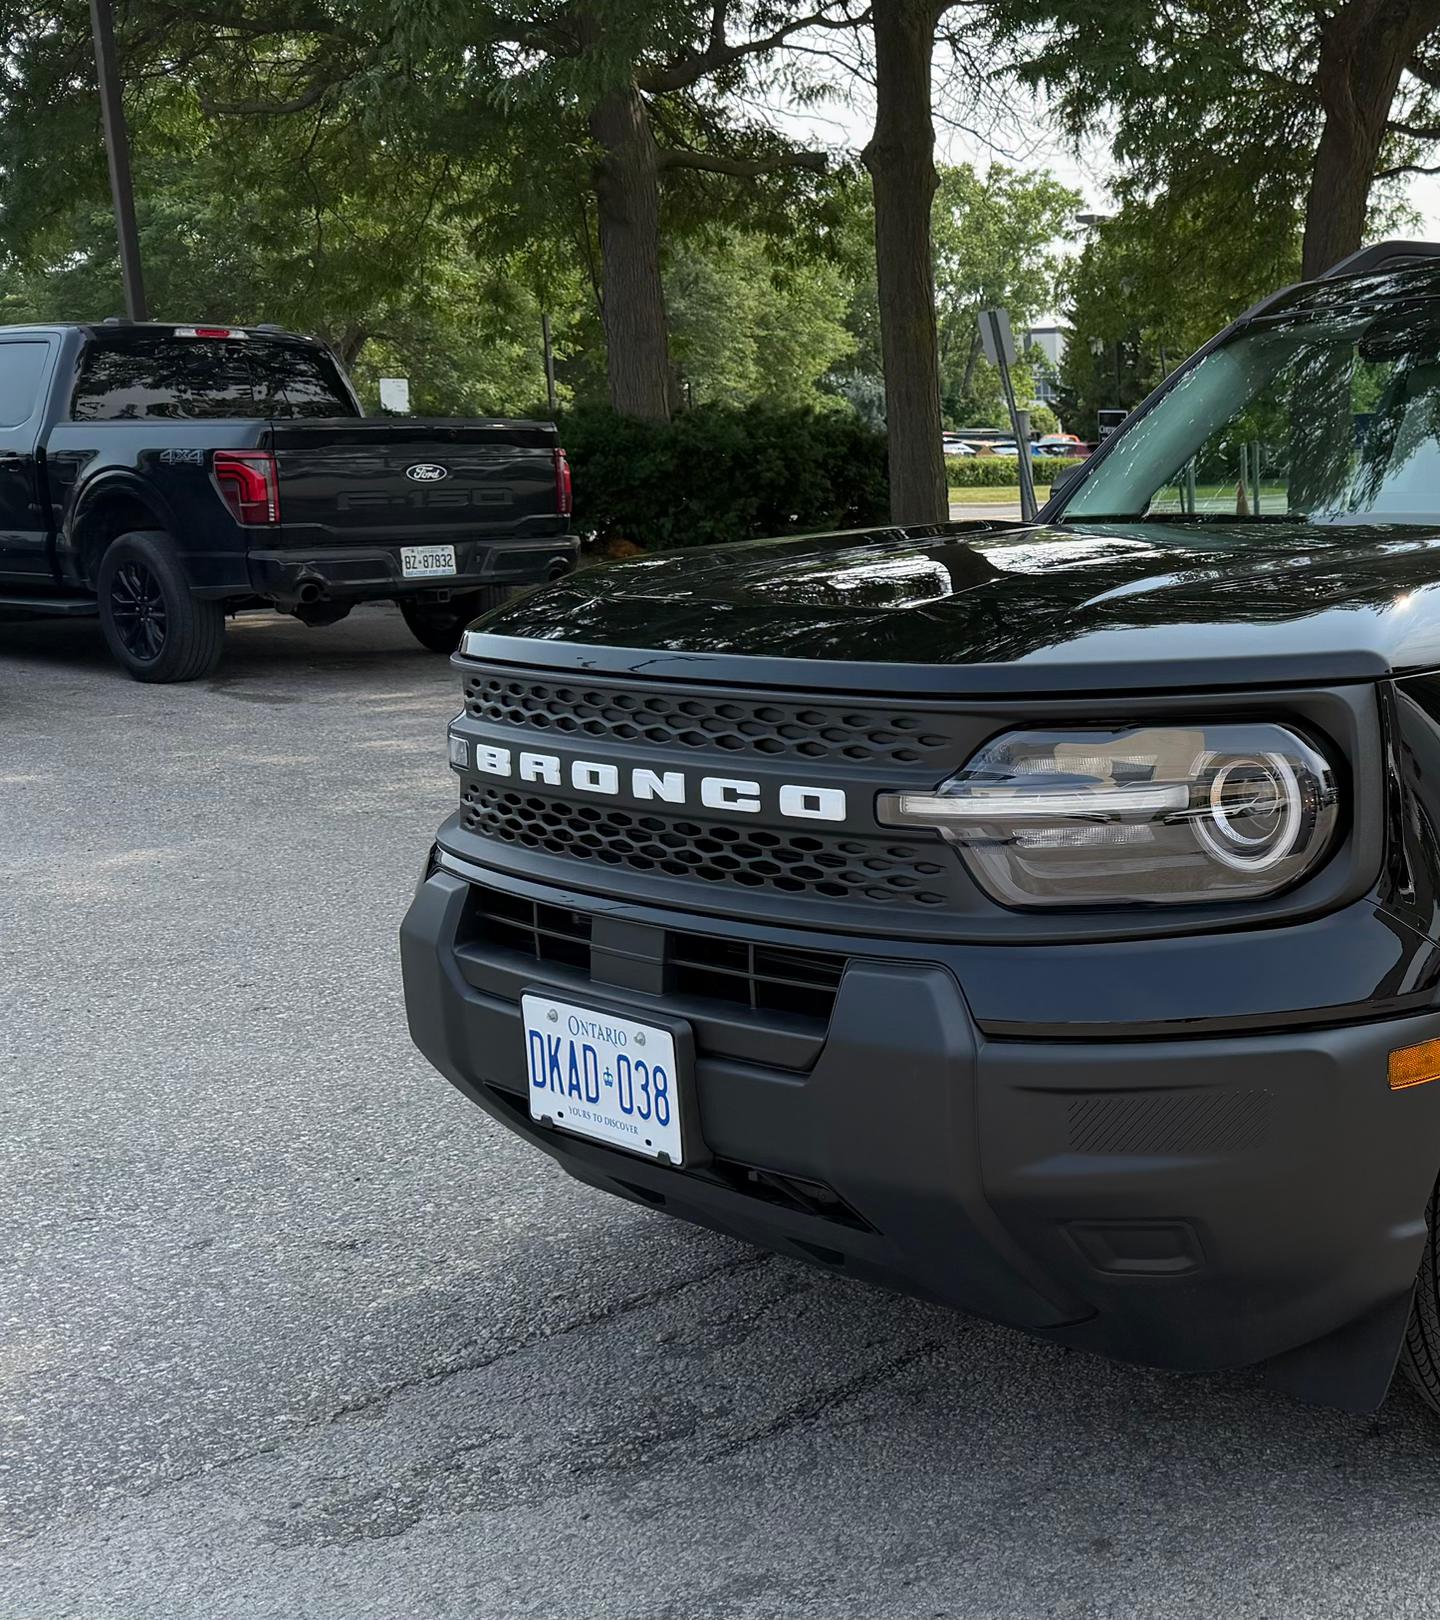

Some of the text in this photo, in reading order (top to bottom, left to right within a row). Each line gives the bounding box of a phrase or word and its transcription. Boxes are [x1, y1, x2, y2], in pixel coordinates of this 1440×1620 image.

[412, 466, 441, 480] Ford
[336, 487, 515, 510] F-150
[404, 553, 454, 570] BZ 87832
[476, 744, 847, 822] BRONCO
[529, 1030, 670, 1126] DKAD 038
[568, 1106, 638, 1135] YOURS TO DISCOVER
